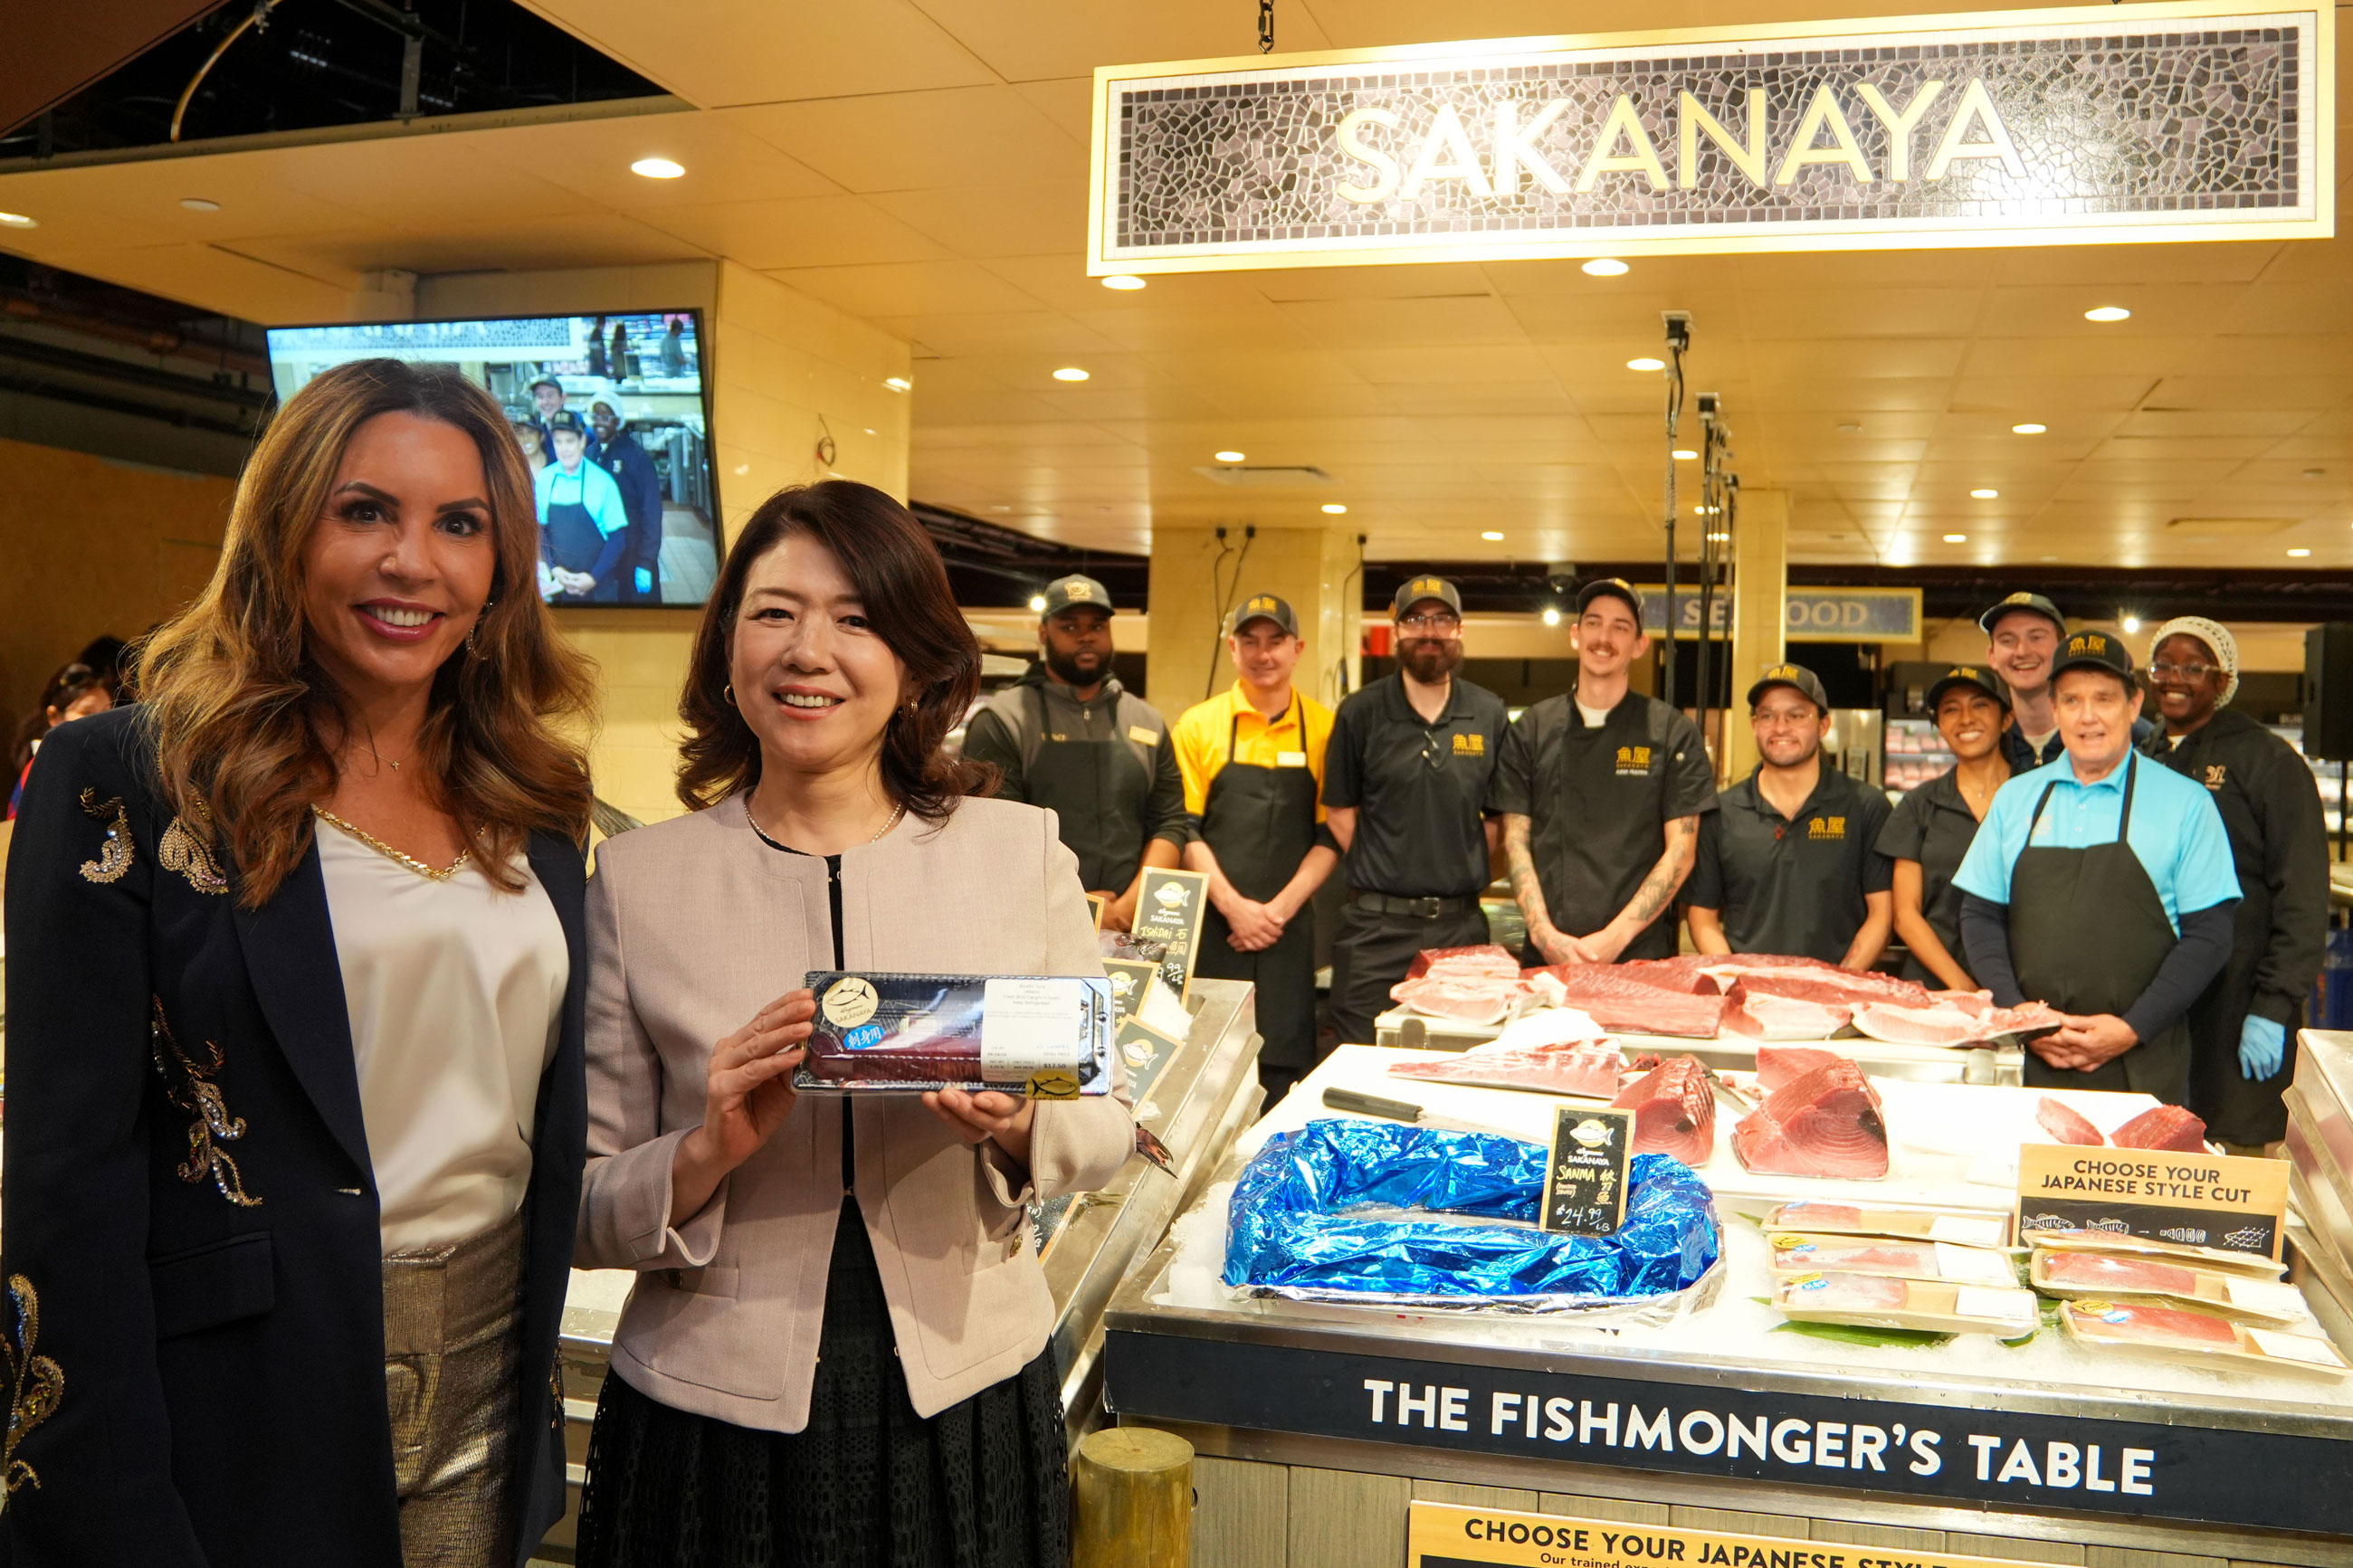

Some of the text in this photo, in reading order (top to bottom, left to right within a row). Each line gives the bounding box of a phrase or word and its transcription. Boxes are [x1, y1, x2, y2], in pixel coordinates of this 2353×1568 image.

[1337, 77, 2028, 204] SAKANAYA
[1682, 599, 1869, 627] SEOOD
[1452, 733, 1484, 750] 魚屋
[1615, 746, 1651, 764] 魚屋
[1808, 815, 1846, 833] 魚屋
[1150, 915, 1185, 925] SAKANAYA
[834, 1008, 872, 1023] SAKANAYA
[847, 1026, 882, 1049] 刺身用
[1567, 1155, 1610, 1166] SAKANAYA
[1556, 1164, 1596, 1183] SANMA
[2073, 1160, 2220, 1183] CHOOSE YOUR
[2042, 1174, 2252, 1203] JAPANESE STYLE CUT
[1364, 1379, 2154, 1496] THE FISHMONGER'S TABLE
[1464, 1519, 1589, 1552] CHOOSE
[1601, 1532, 1685, 1561] YOUR
[1540, 1553, 1620, 1568] Our trained
